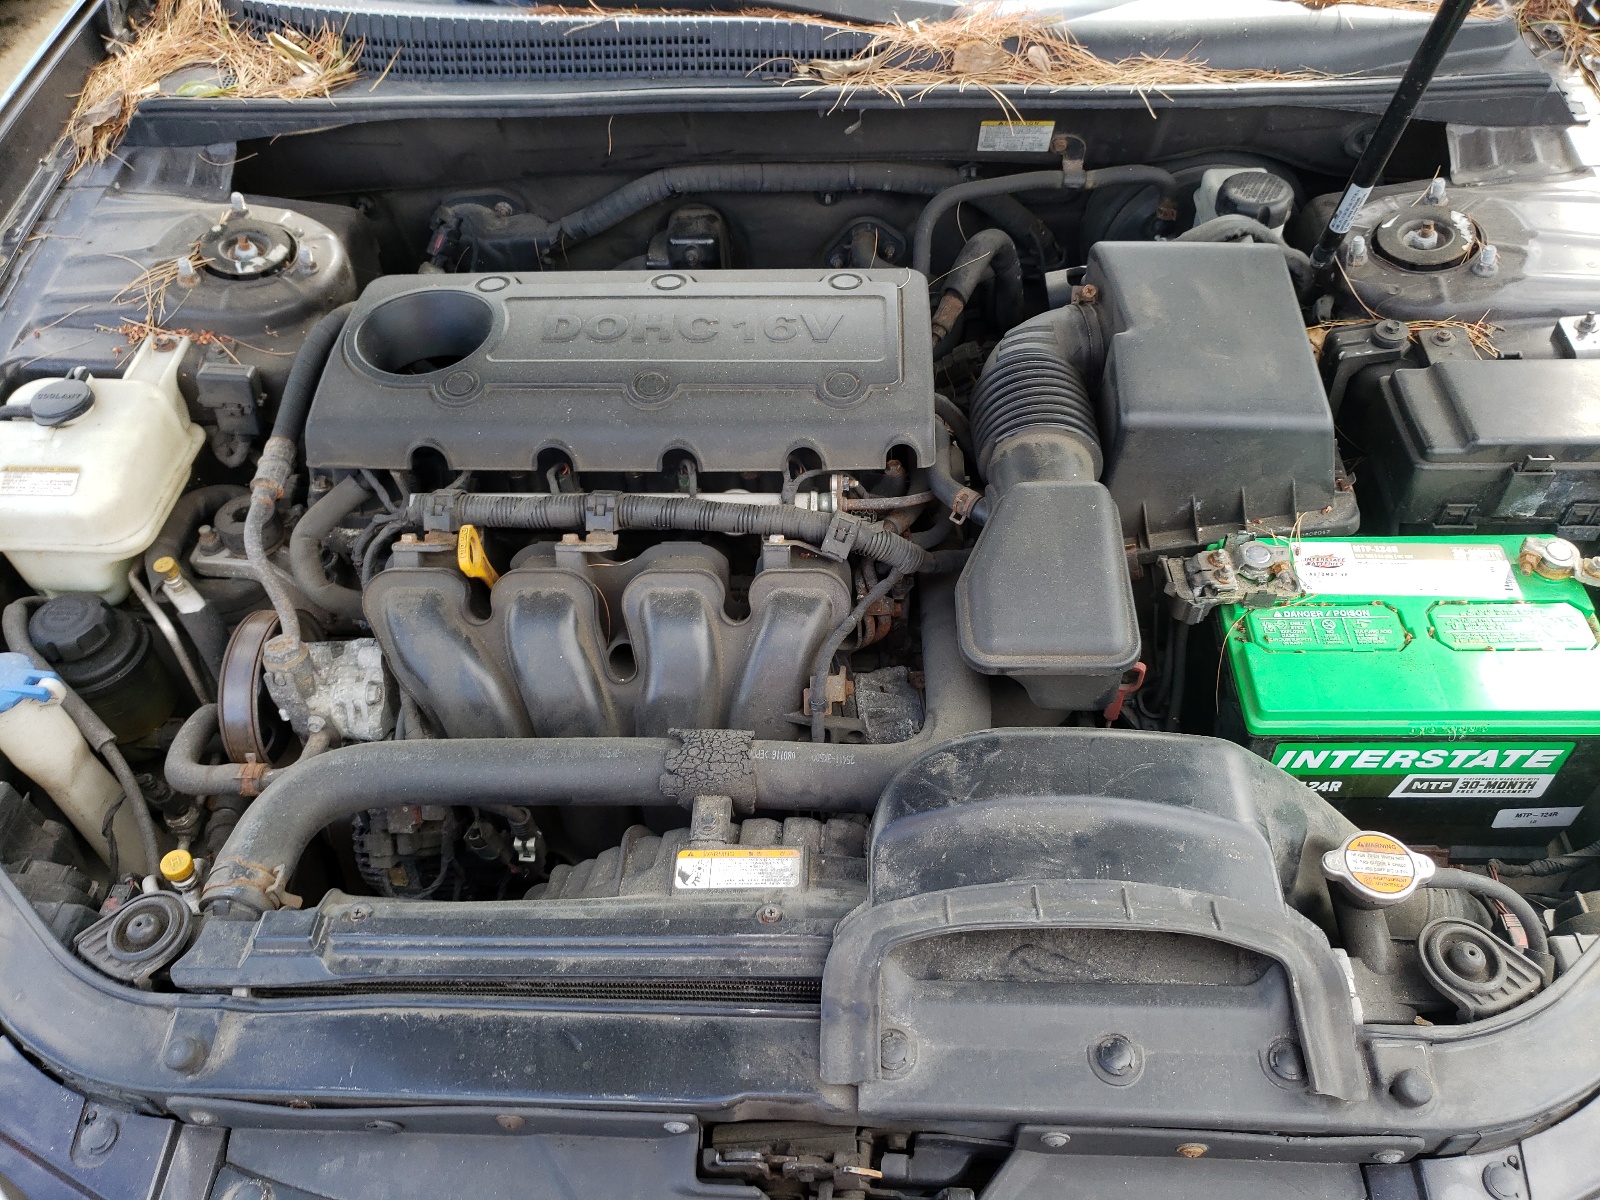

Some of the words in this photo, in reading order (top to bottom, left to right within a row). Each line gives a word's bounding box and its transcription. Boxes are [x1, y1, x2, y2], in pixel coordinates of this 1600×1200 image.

[541, 313, 719, 343] DOHC
[733, 313, 845, 343] 16V
[1276, 749, 1566, 769] INTERSTATE
[1411, 781, 1453, 790] MTP
[1459, 780, 1538, 790] 30-MONTH
[1364, 842, 1397, 850] WARNING
